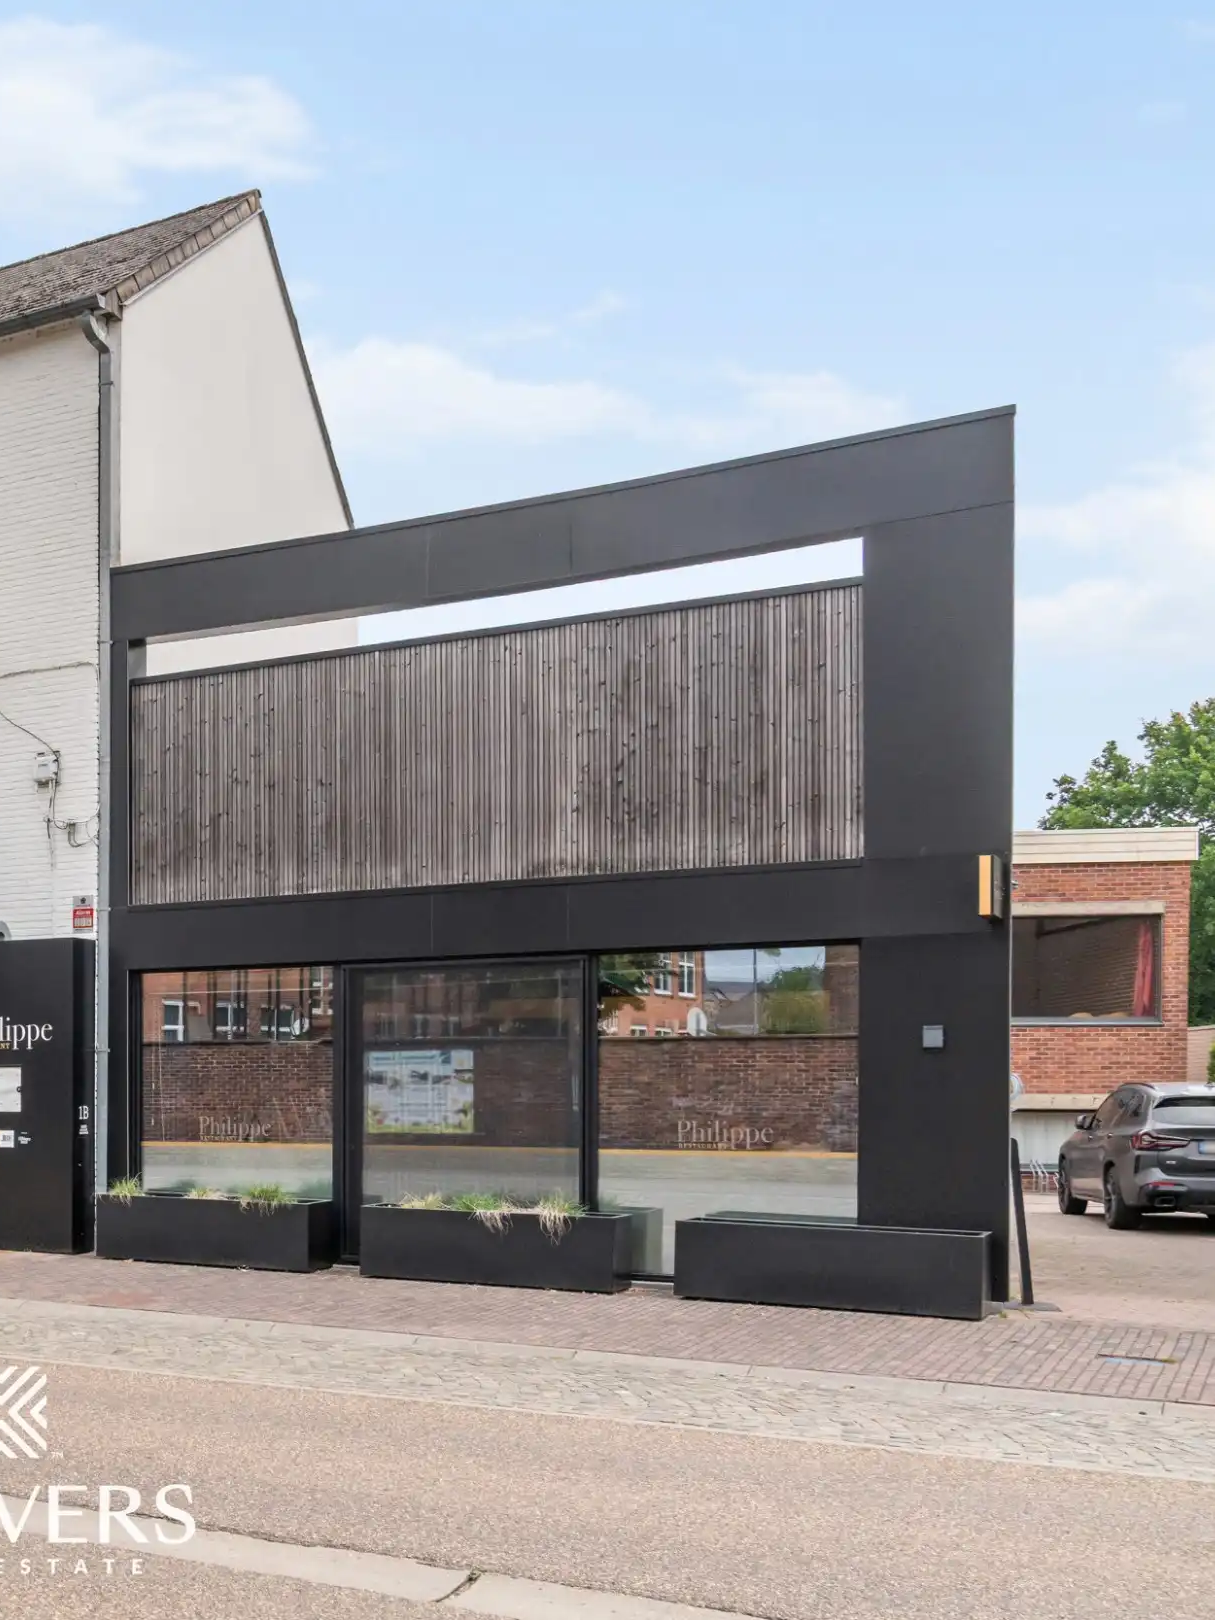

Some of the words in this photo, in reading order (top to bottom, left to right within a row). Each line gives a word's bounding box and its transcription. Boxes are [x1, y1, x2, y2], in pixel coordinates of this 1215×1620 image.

[78, 1105, 90, 1120] 1B
[198, 1115, 272, 1143] Philippe
[677, 1120, 774, 1150] Philippe
